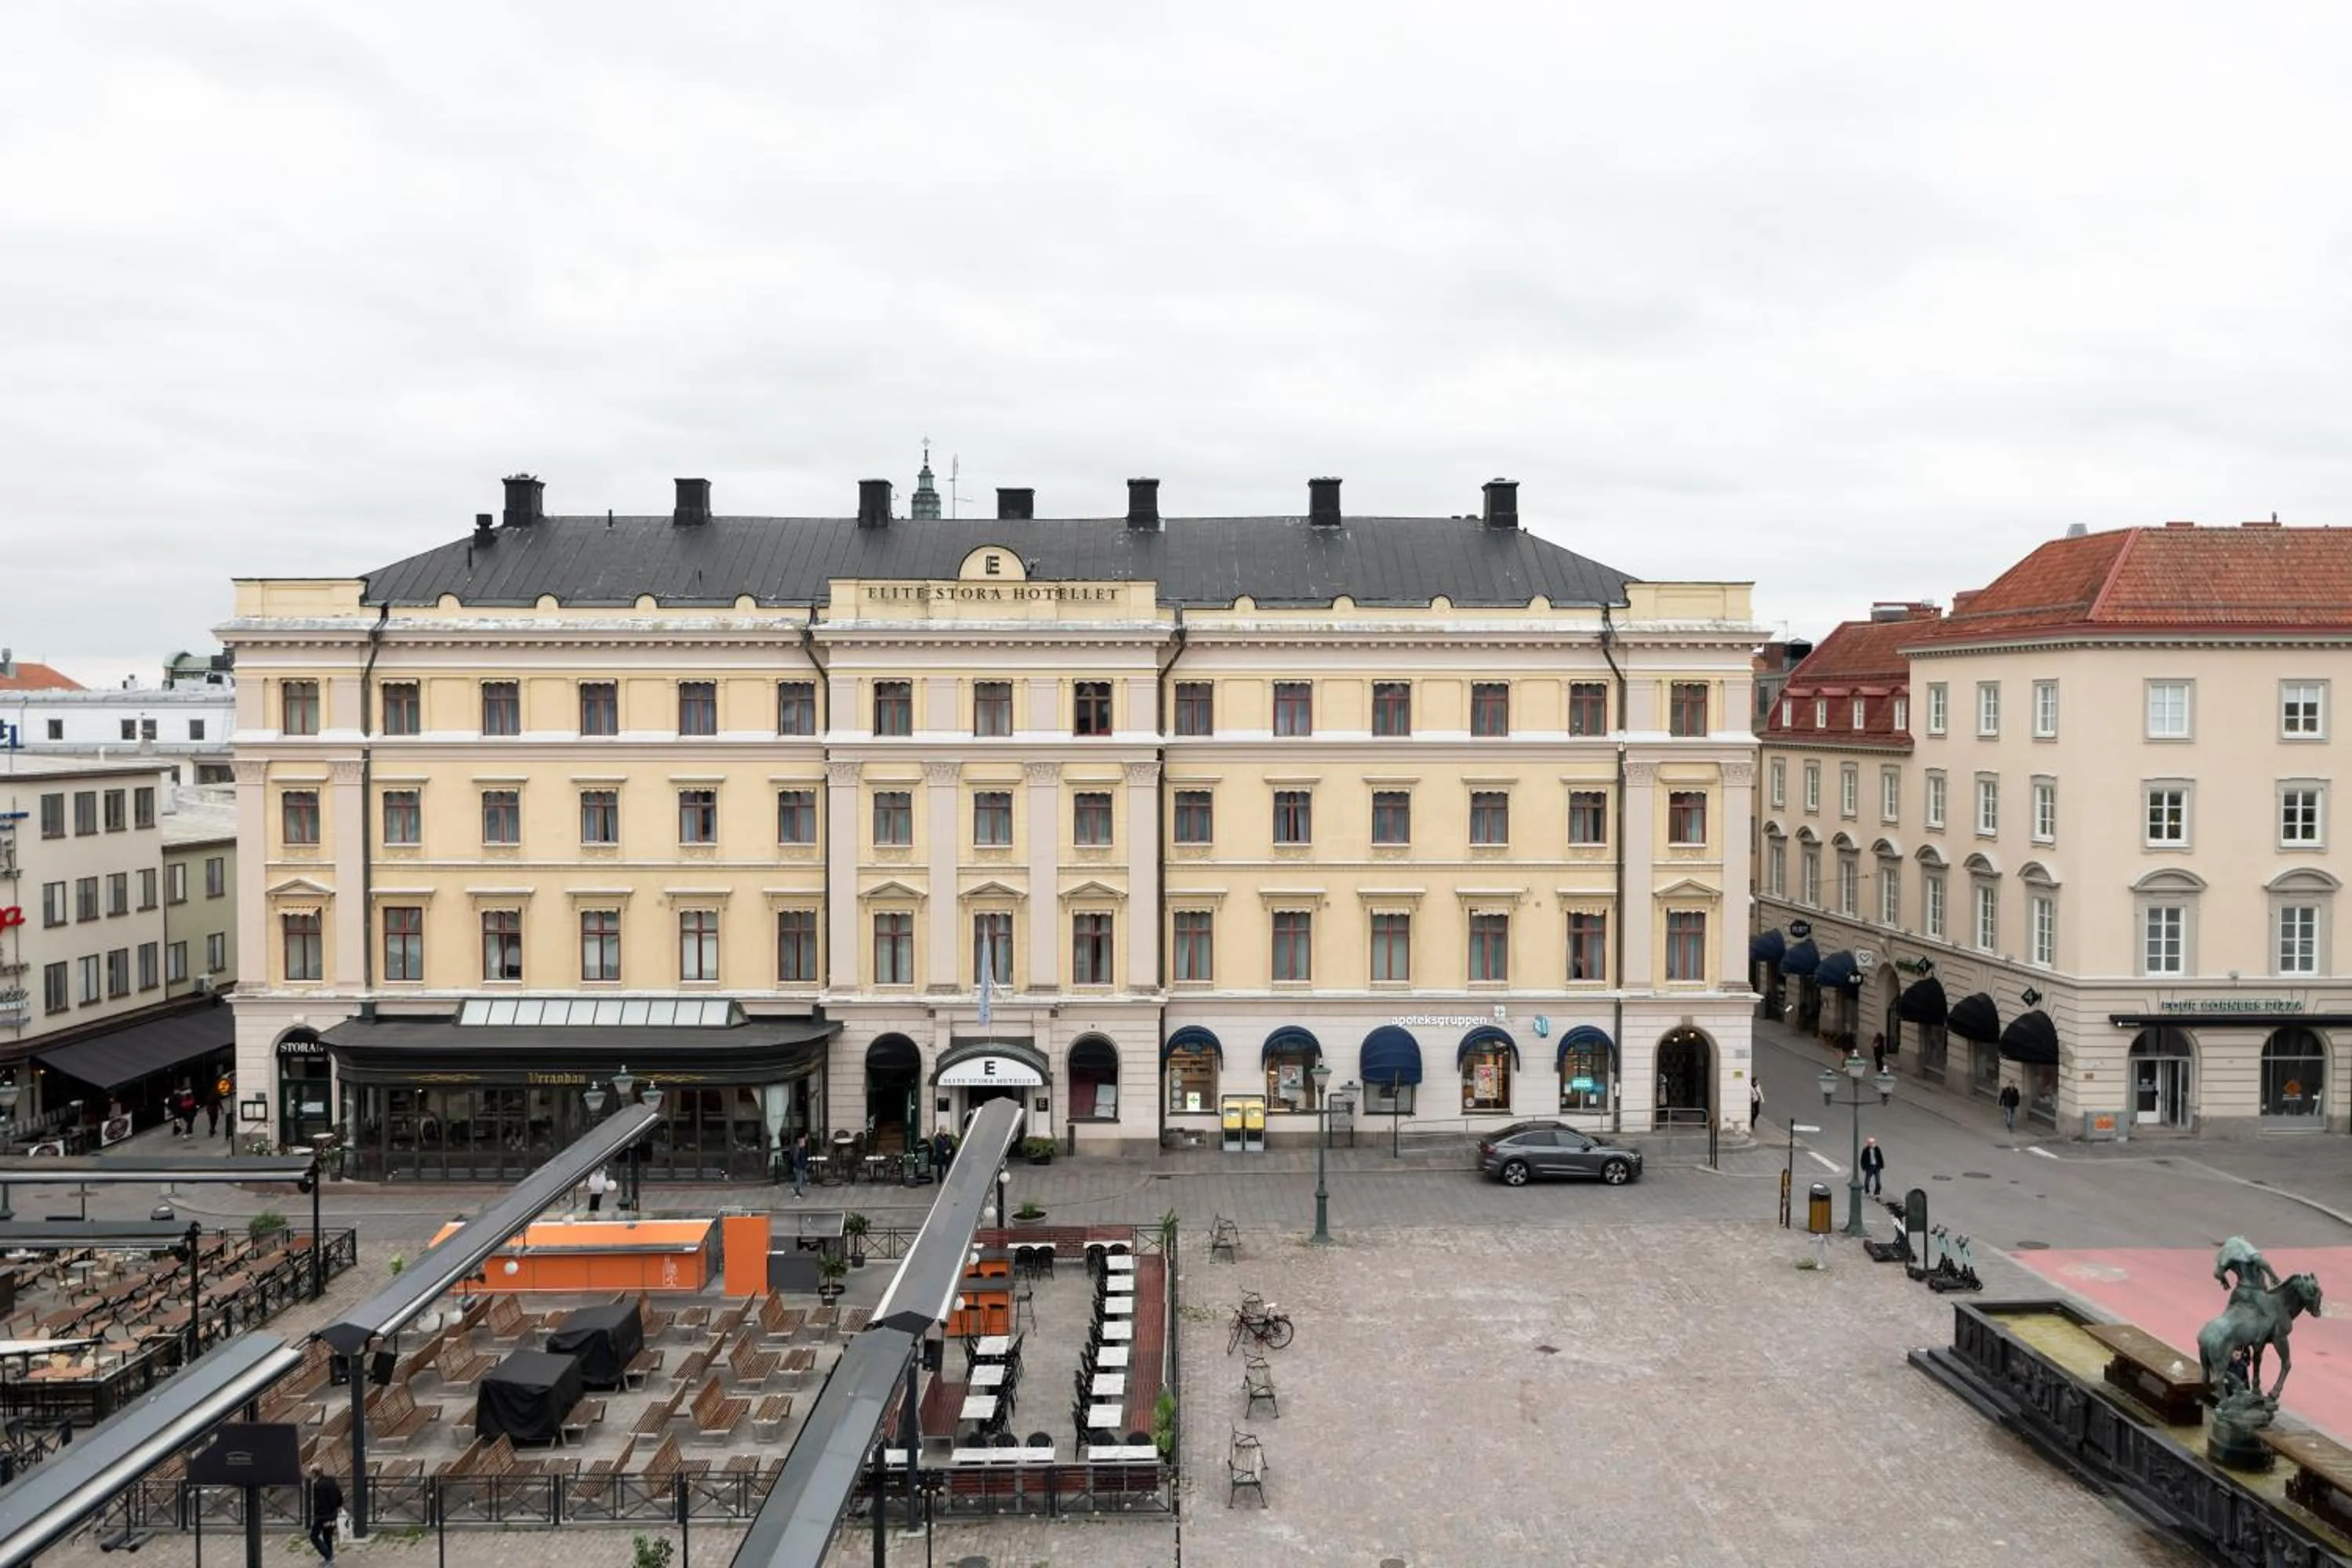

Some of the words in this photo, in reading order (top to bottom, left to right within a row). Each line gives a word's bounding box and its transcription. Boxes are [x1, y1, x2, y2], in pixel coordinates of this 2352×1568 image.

[985, 555, 1000, 575] E
[868, 587, 928, 599] ELITE
[936, 587, 1001, 600] STORA
[1013, 588, 1120, 600] HOTELLET
[1392, 1014, 1487, 1026] apoteksgruppen
[984, 1060, 996, 1075] E
